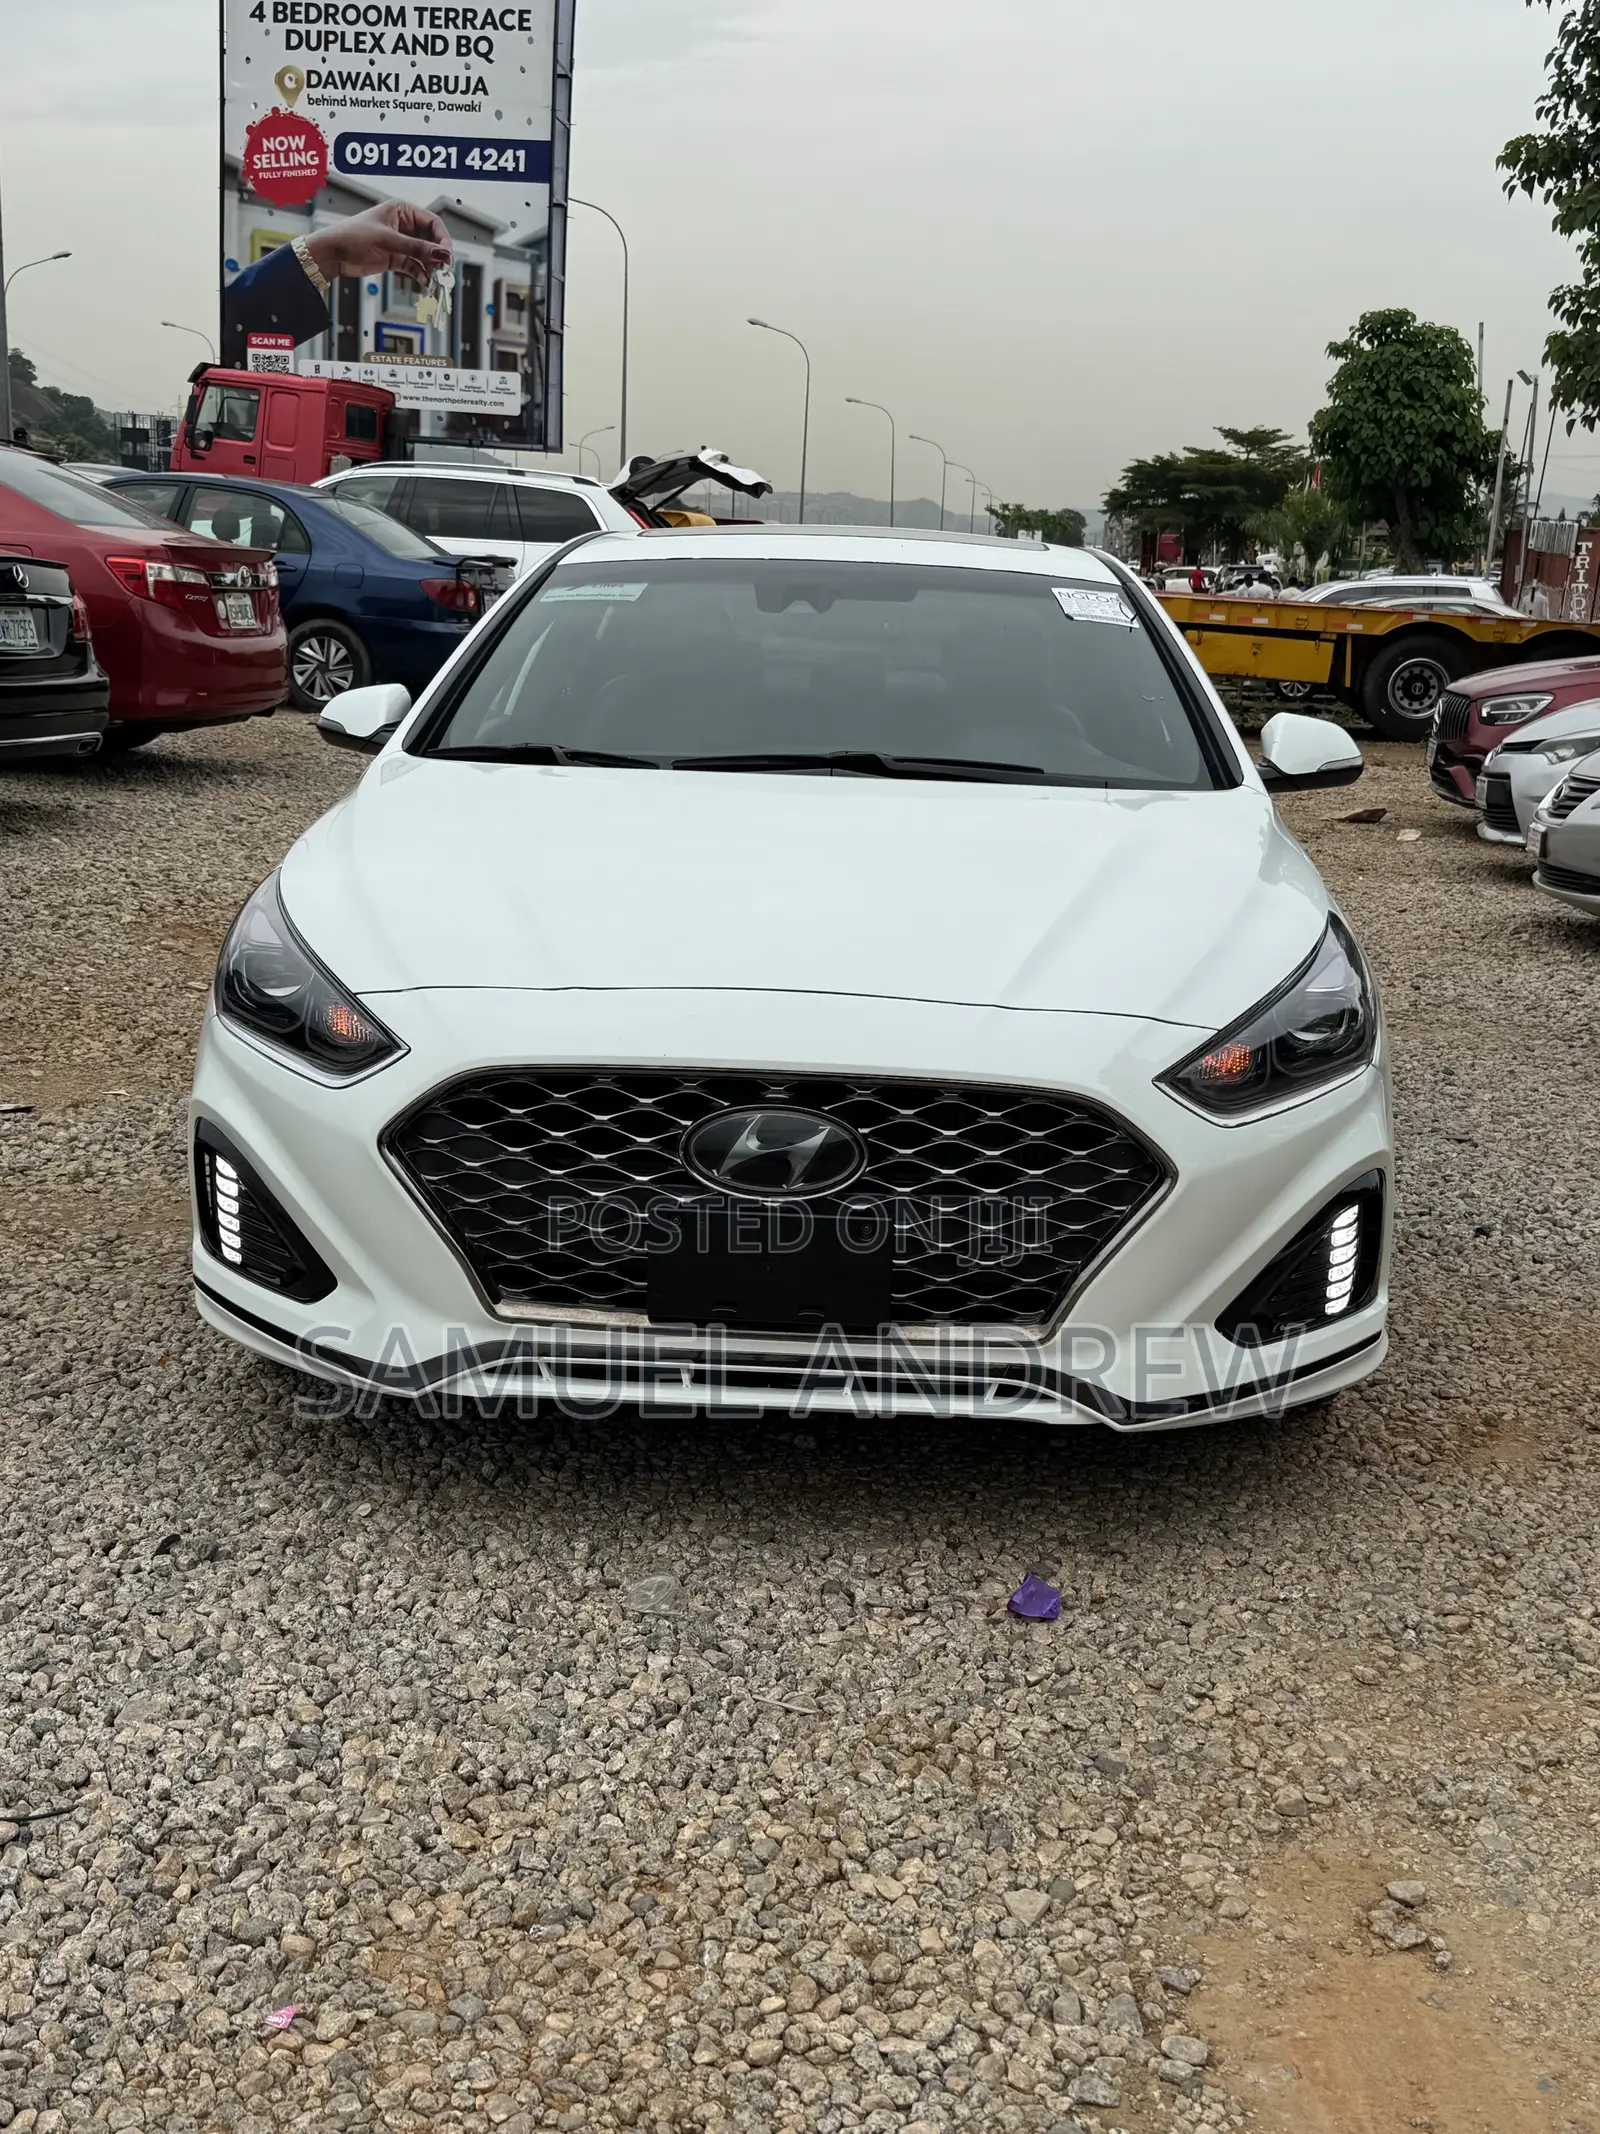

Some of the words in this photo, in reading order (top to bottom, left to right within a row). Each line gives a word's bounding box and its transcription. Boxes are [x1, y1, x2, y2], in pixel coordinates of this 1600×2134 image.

[249, 1, 266, 24] 4
[273, 2, 407, 28] BEDROOM
[414, 7, 532, 32] TERRACE
[285, 29, 385, 55] DUPLEX
[390, 33, 449, 57] AND
[455, 35, 494, 63] BQ
[306, 70, 400, 92] DAWAKI
[307, 94, 347, 107] behind
[349, 97, 390, 110] Market
[392, 99, 436, 113] Square,
[438, 101, 482, 113] Dawaki
[262, 135, 306, 151] NOW
[252, 151, 320, 170] SELLING
[345, 142, 390, 166] 091
[397, 145, 458, 169] 2021
[465, 147, 526, 172] 4241
[259, 170, 282, 180] FULLY
[283, 168, 318, 179] FINISHED
[251, 336, 275, 346] SCAN
[277, 338, 291, 347] ME
[370, 355, 401, 365] ESTATE
[404, 356, 448, 367] FEATURES
[402, 394, 505, 408] www.thenorthpolerealty.com
